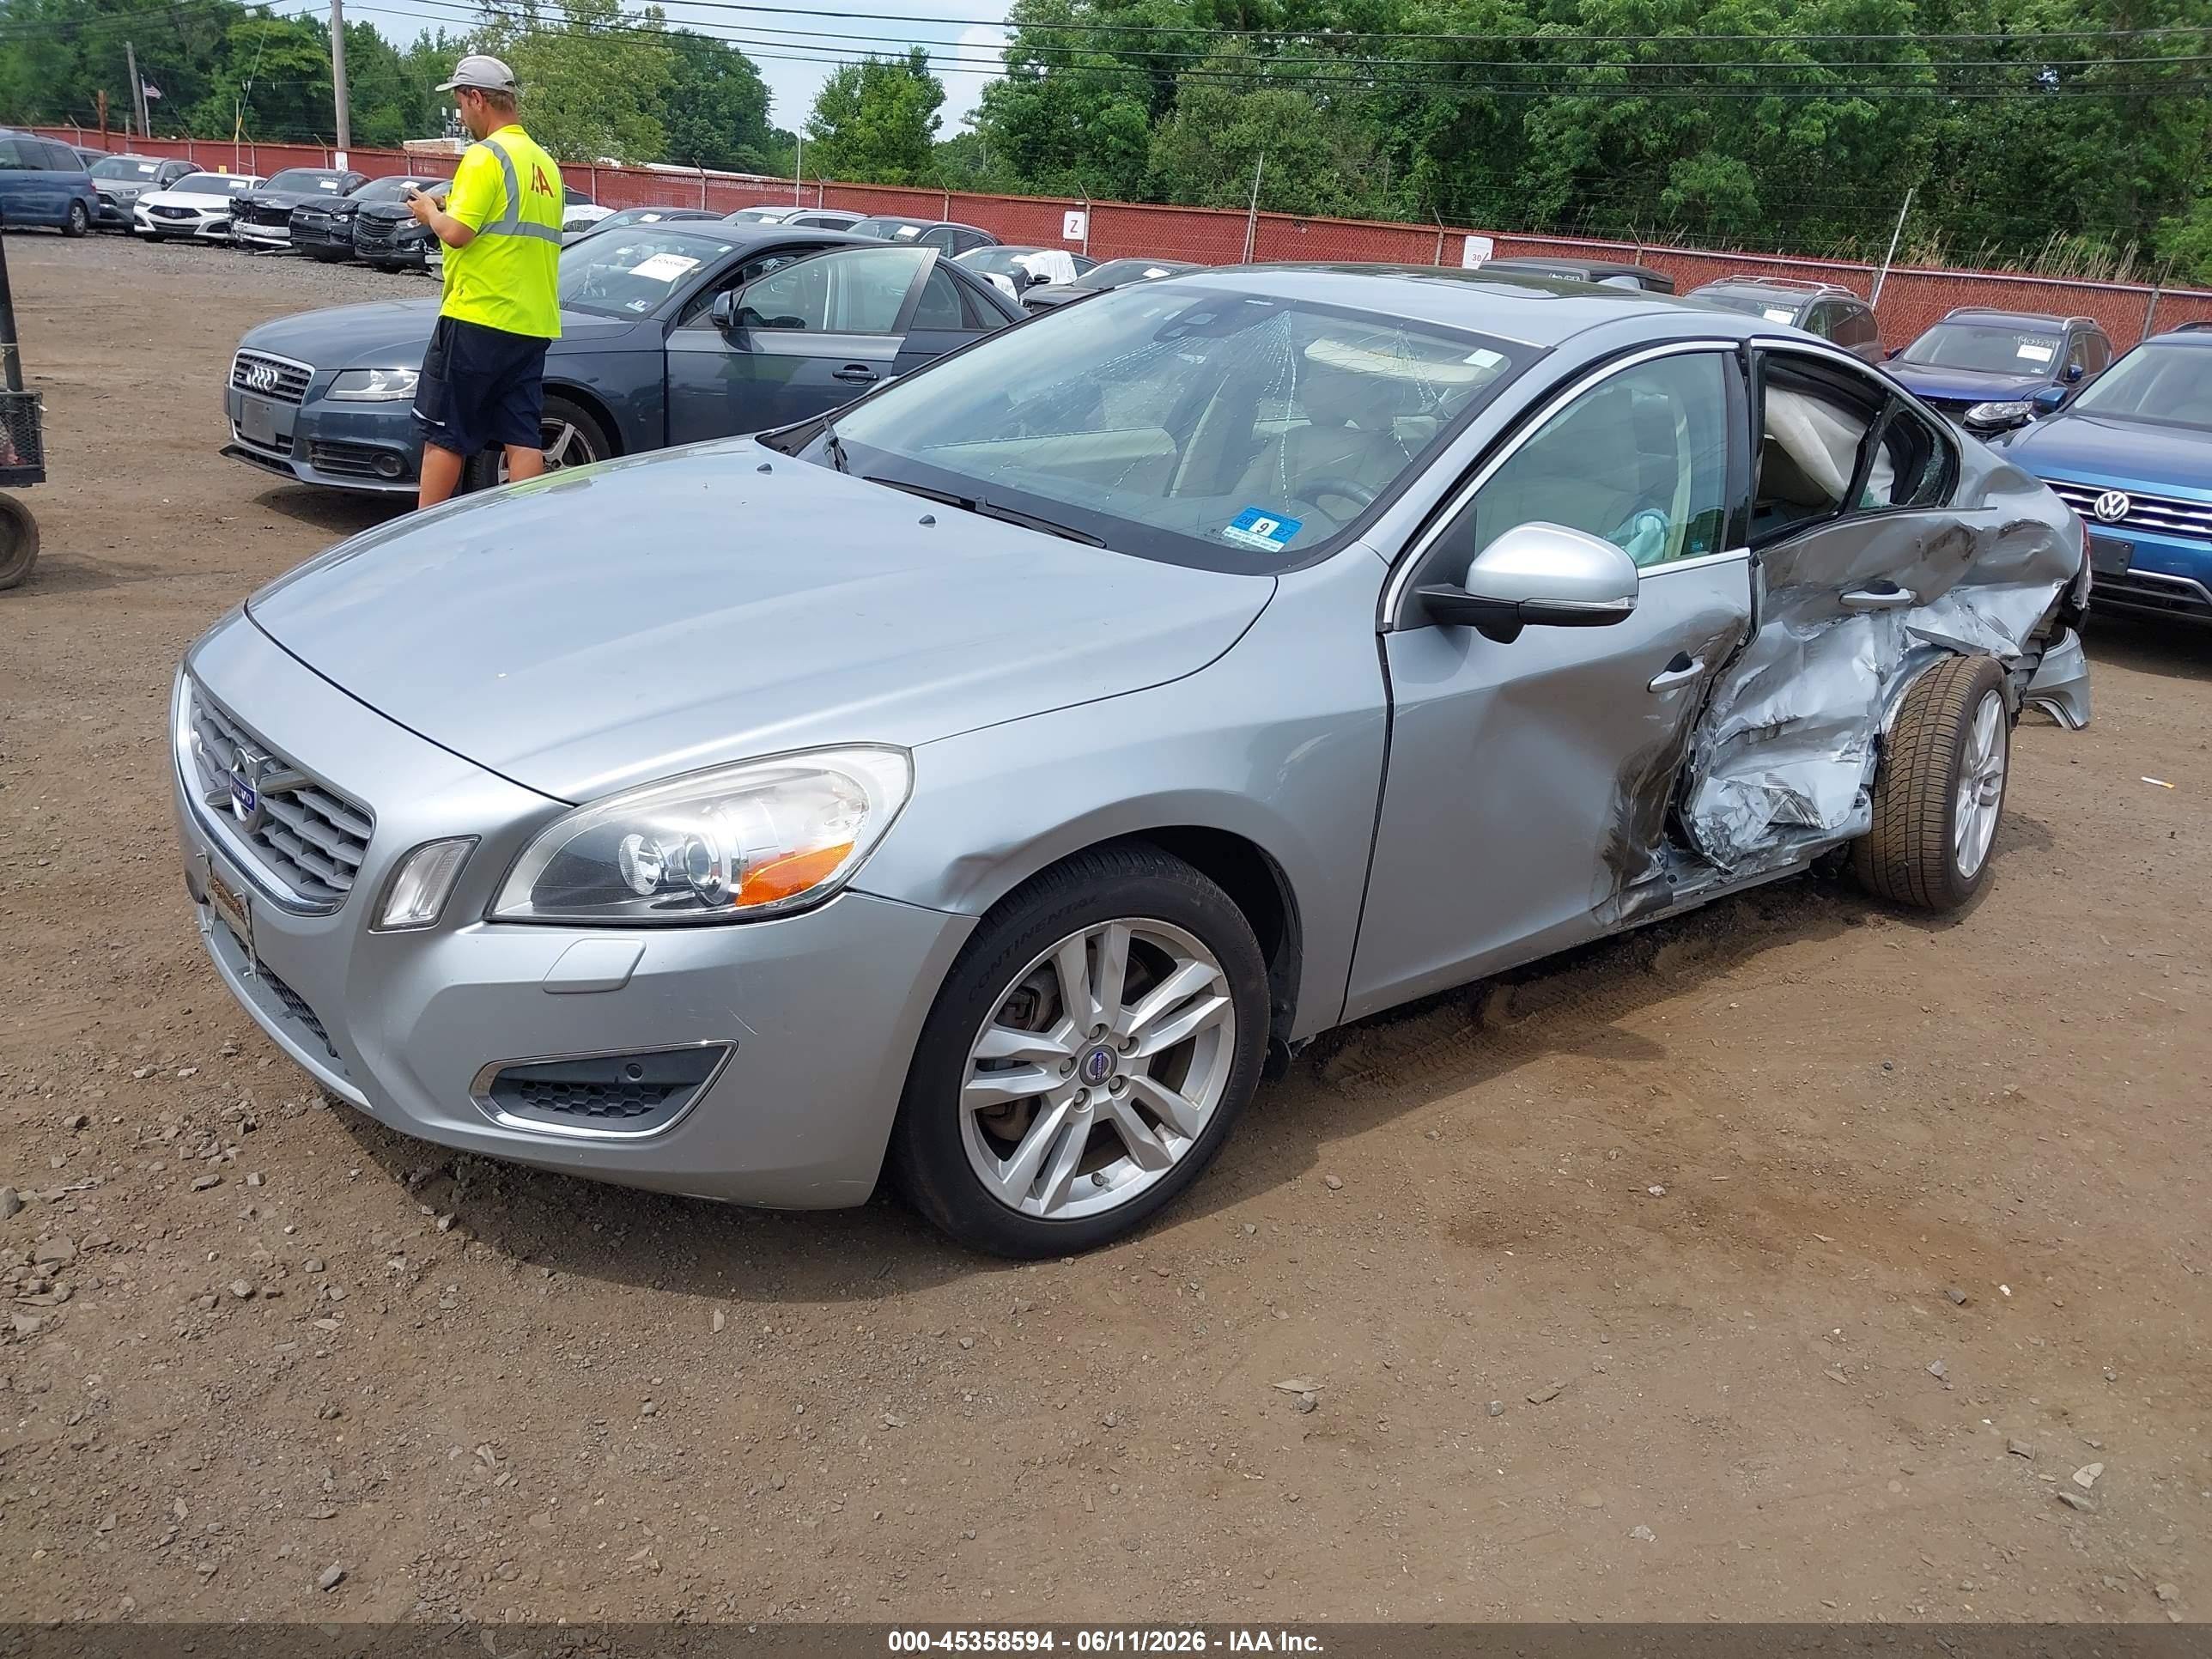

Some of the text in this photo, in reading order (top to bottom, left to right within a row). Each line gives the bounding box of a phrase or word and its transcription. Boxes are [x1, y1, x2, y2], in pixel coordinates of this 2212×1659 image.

[1070, 219, 1079, 233] Z
[1239, 515, 1254, 526] 20
[1256, 522, 1270, 533] 9
[232, 781, 252, 805] OLVO
